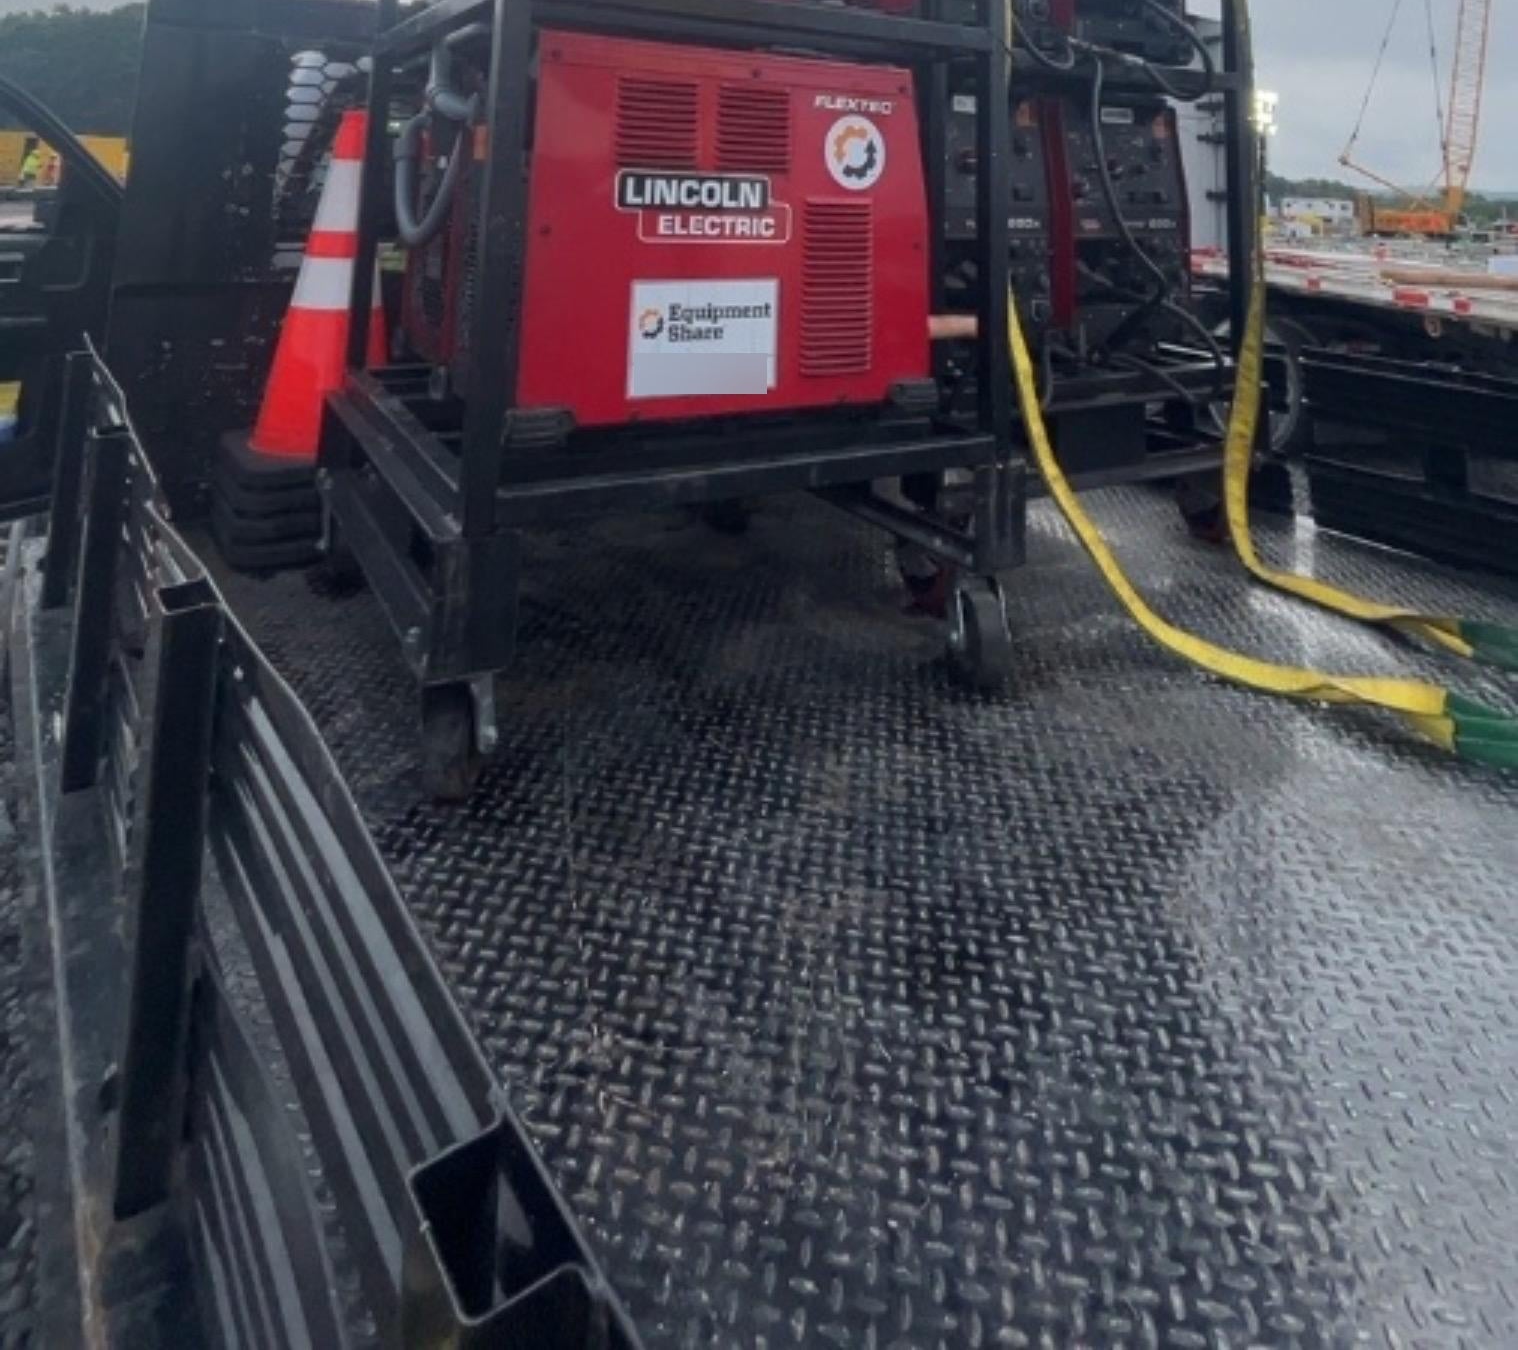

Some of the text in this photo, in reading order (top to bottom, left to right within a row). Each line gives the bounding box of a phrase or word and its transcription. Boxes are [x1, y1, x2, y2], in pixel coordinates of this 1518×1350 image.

[815, 94, 893, 115] FLEXTEC
[625, 176, 762, 209] LINCOLN
[657, 214, 775, 238] ELECTRIC
[668, 302, 772, 325] Equipment
[668, 324, 725, 342] Share
